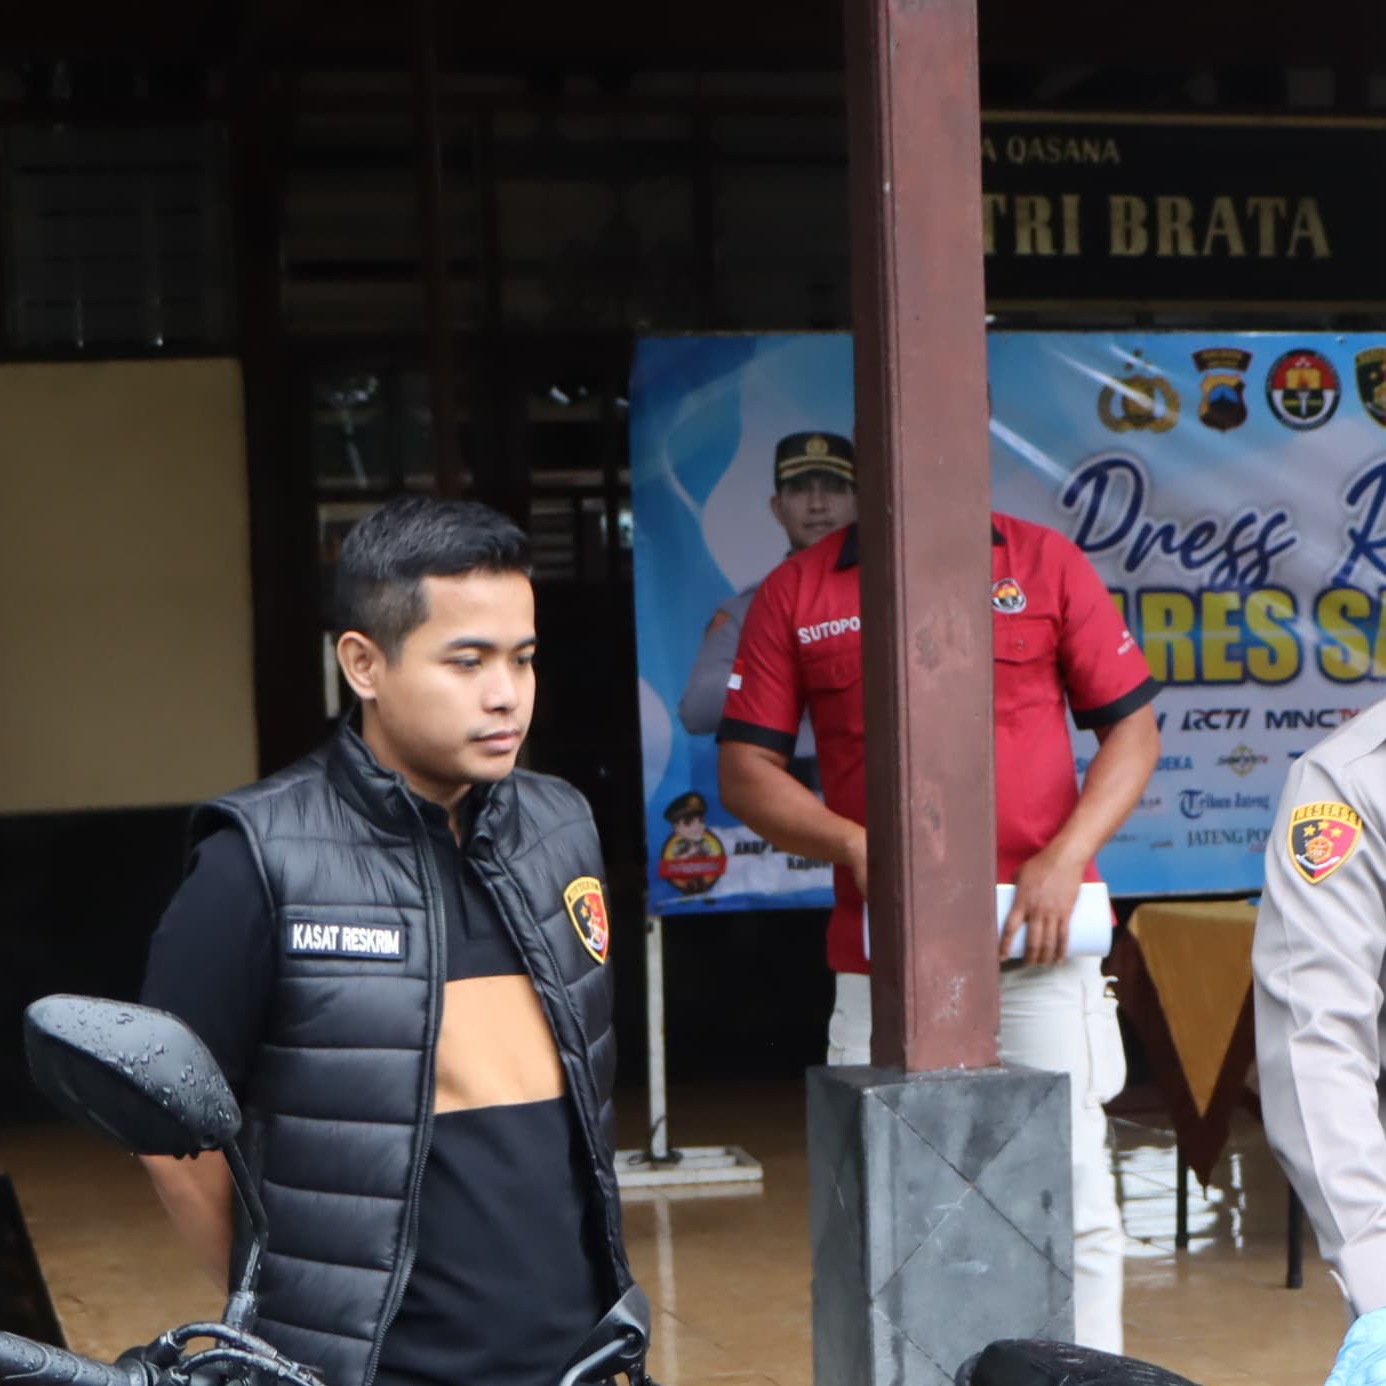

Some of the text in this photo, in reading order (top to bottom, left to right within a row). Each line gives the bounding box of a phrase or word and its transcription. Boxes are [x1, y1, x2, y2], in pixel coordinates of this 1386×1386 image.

[1007, 136, 1121, 164] QASANA
[1109, 194, 1332, 257] BRATA
[797, 615, 861, 645] SUTOPO
[1113, 588, 1301, 685] RES
[1181, 708, 1251, 731] RCTI
[293, 923, 401, 955] KASAT RESKRIM
